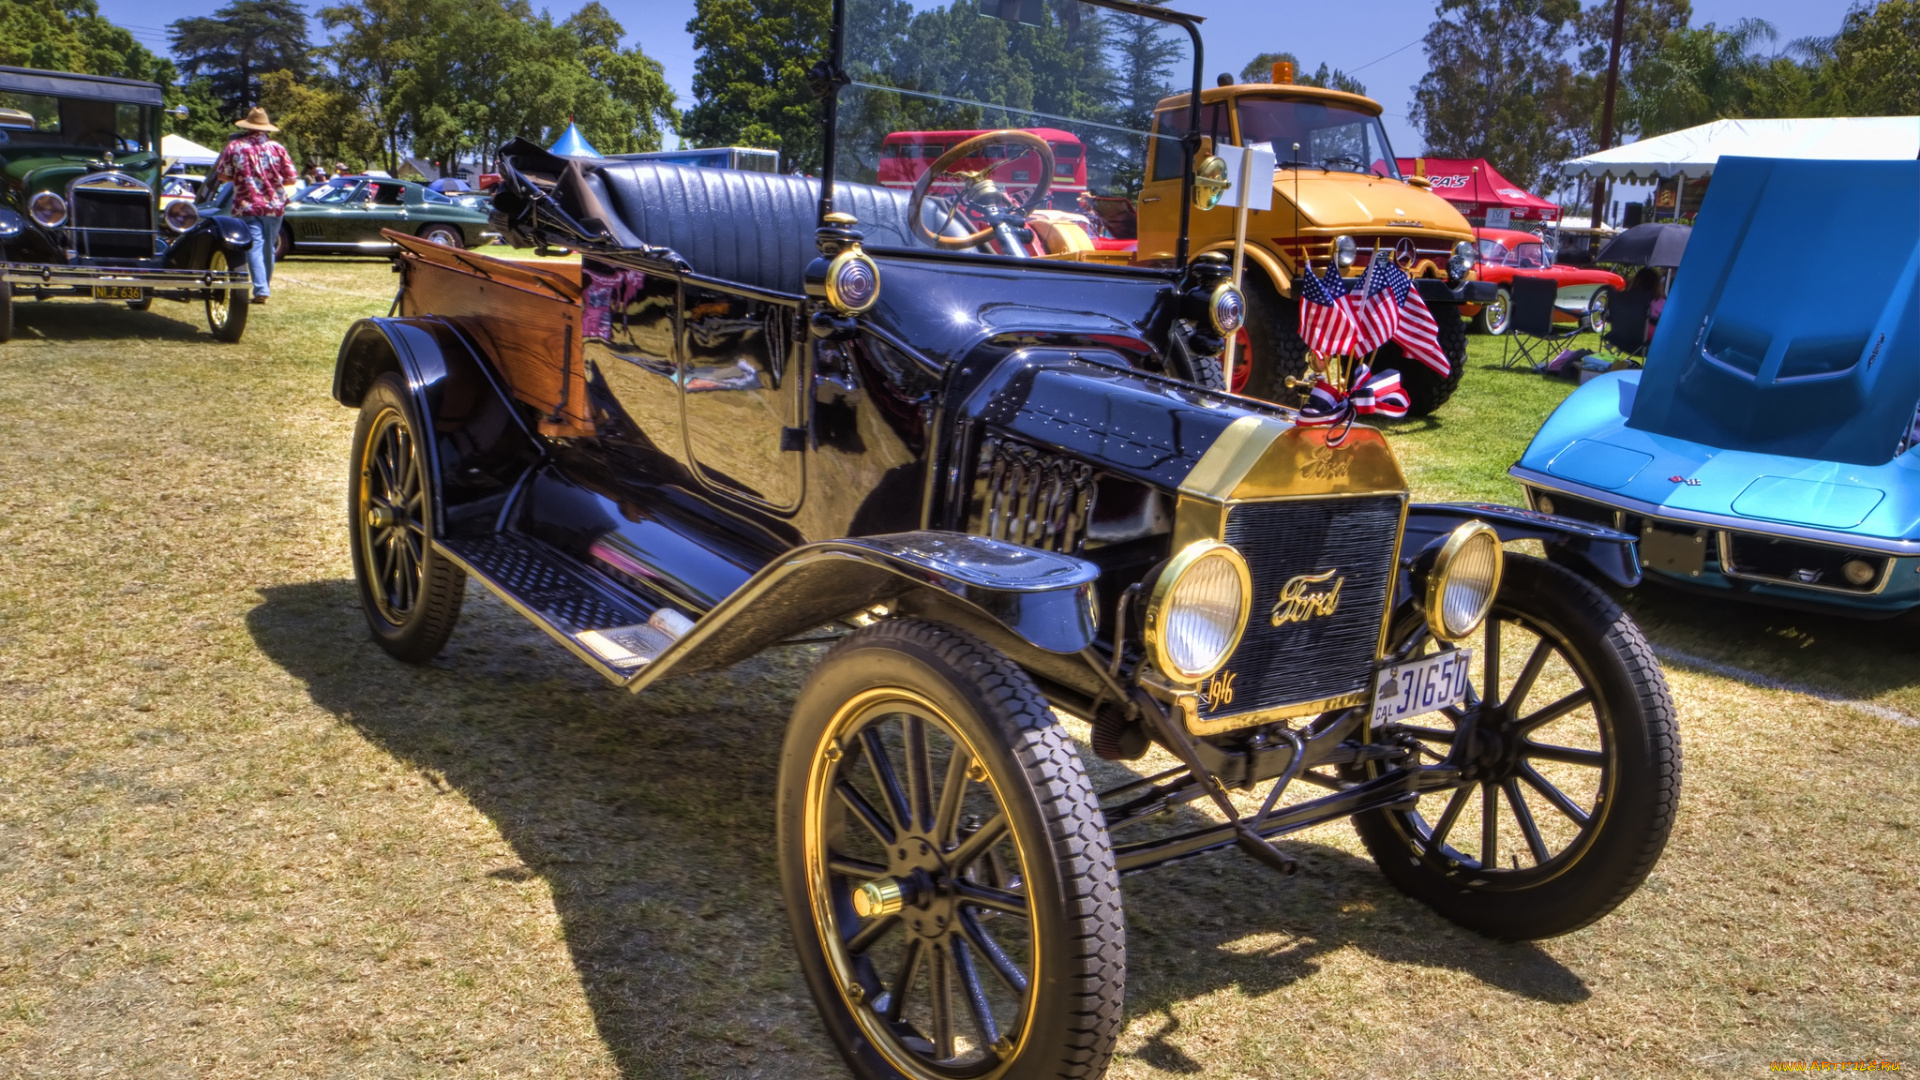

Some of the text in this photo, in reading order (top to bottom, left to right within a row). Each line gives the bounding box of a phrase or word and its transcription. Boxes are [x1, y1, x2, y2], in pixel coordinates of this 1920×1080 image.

[1300, 443, 1354, 480] Ford
[1270, 567, 1345, 627] Ford
[1208, 669, 1238, 713] 1916
[1375, 655, 1470, 720] CAL 31650
